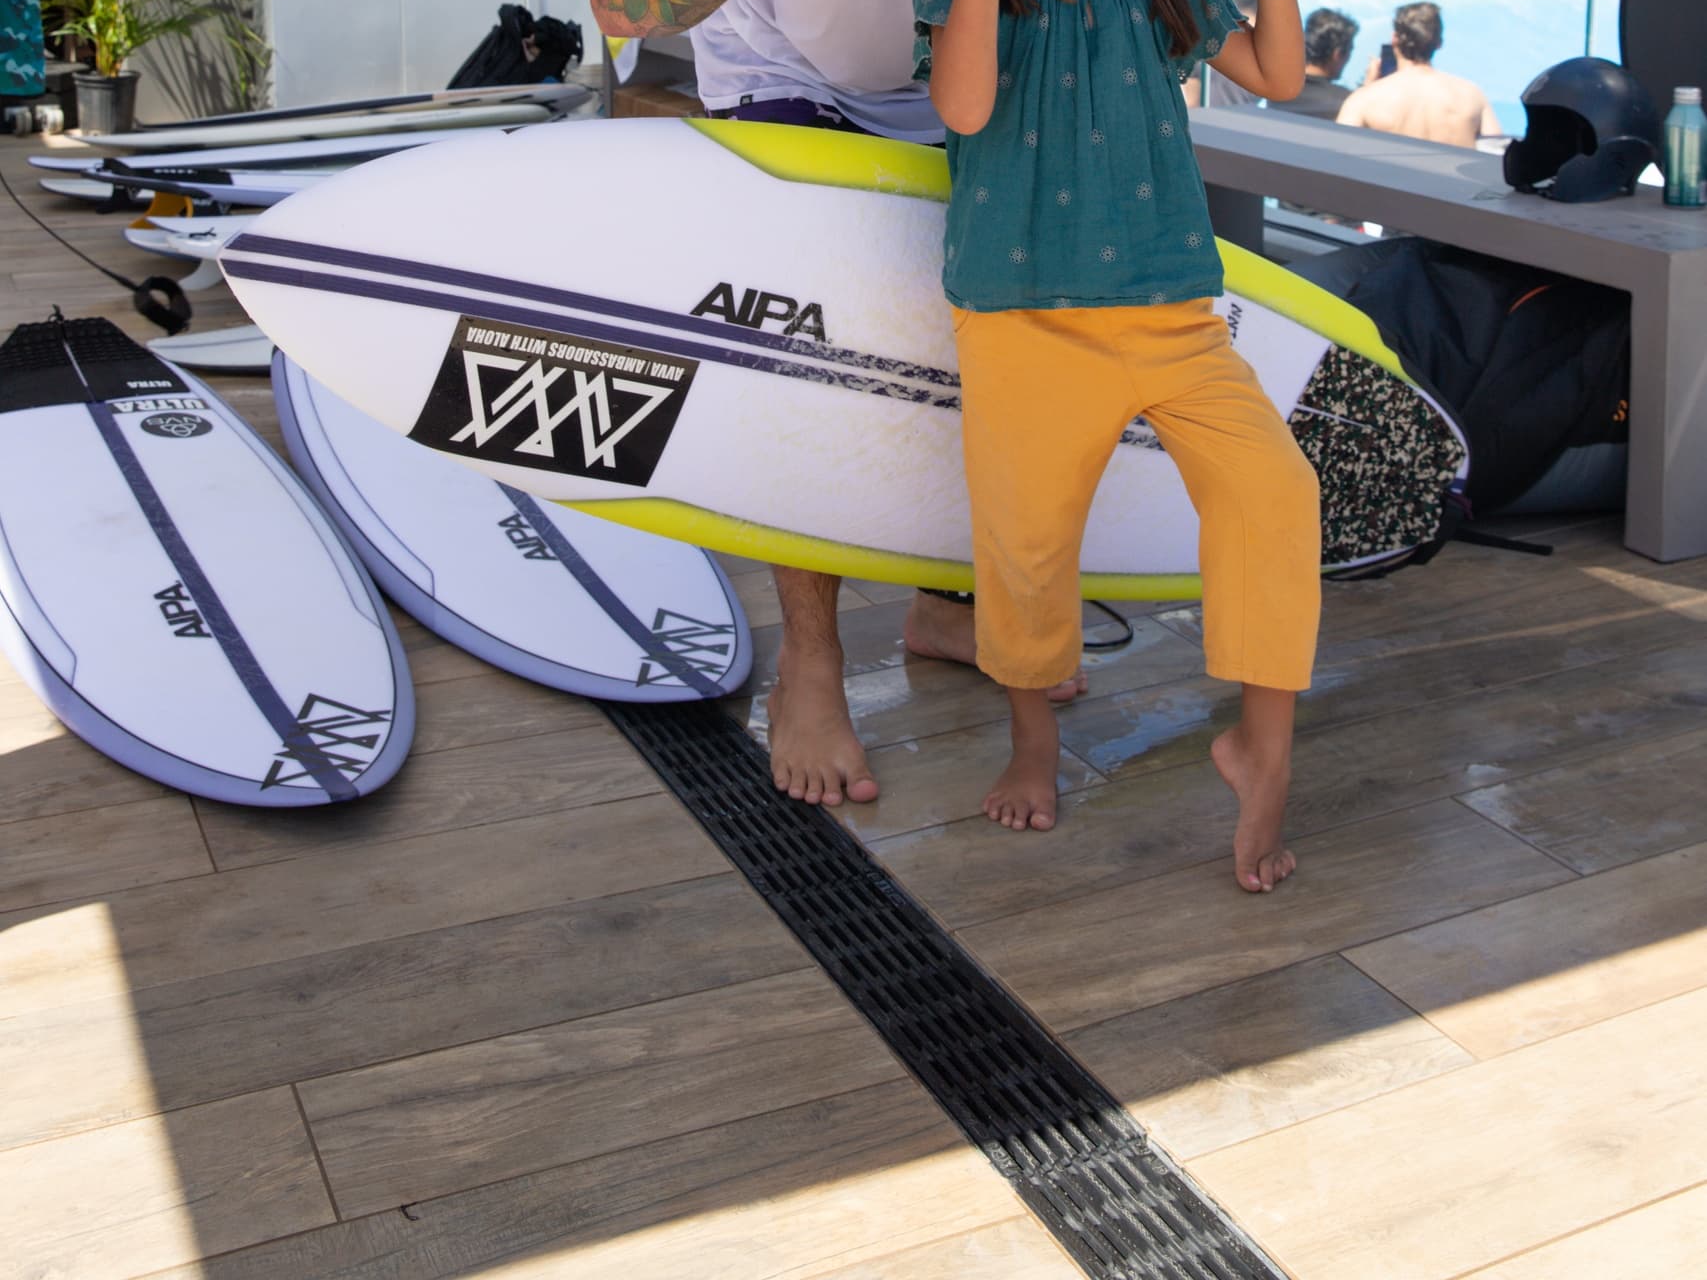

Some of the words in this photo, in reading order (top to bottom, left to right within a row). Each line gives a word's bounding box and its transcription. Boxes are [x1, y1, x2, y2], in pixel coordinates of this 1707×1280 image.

[690, 281, 826, 342] AIPA
[466, 326, 507, 348] ALOHA
[510, 334, 547, 355] WITH
[548, 342, 647, 374] AMBASSADORS
[649, 361, 684, 382] AVVA
[113, 399, 205, 413] ULTRA
[498, 513, 561, 561] AIPA
[153, 582, 213, 638] AIPA
